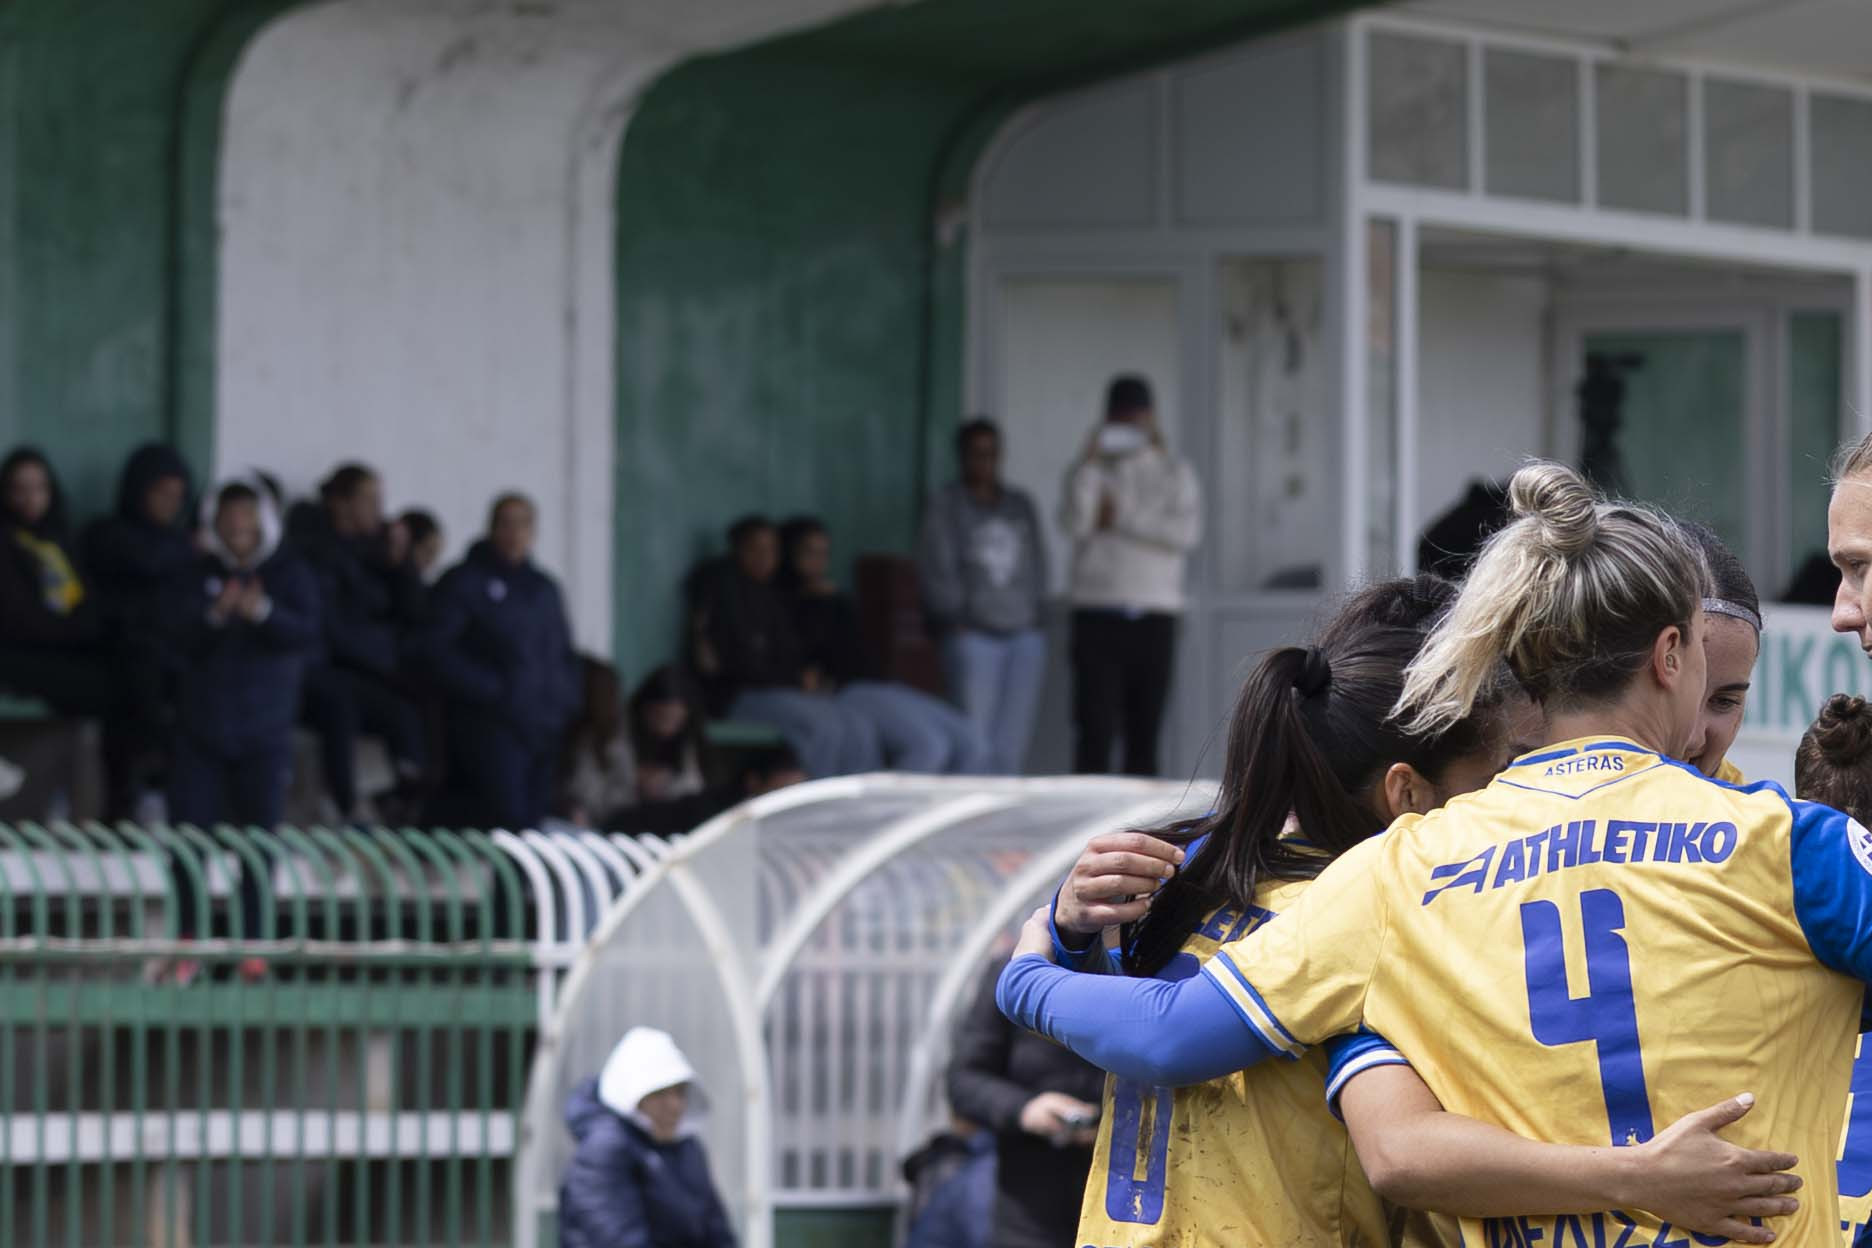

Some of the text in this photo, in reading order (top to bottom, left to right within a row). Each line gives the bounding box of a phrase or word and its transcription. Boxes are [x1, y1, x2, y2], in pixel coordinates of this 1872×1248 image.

[1545, 754, 1624, 776] ASTERAS
[1493, 820, 1738, 888] ATHLETIKO
[1519, 888, 1655, 1147] 4
